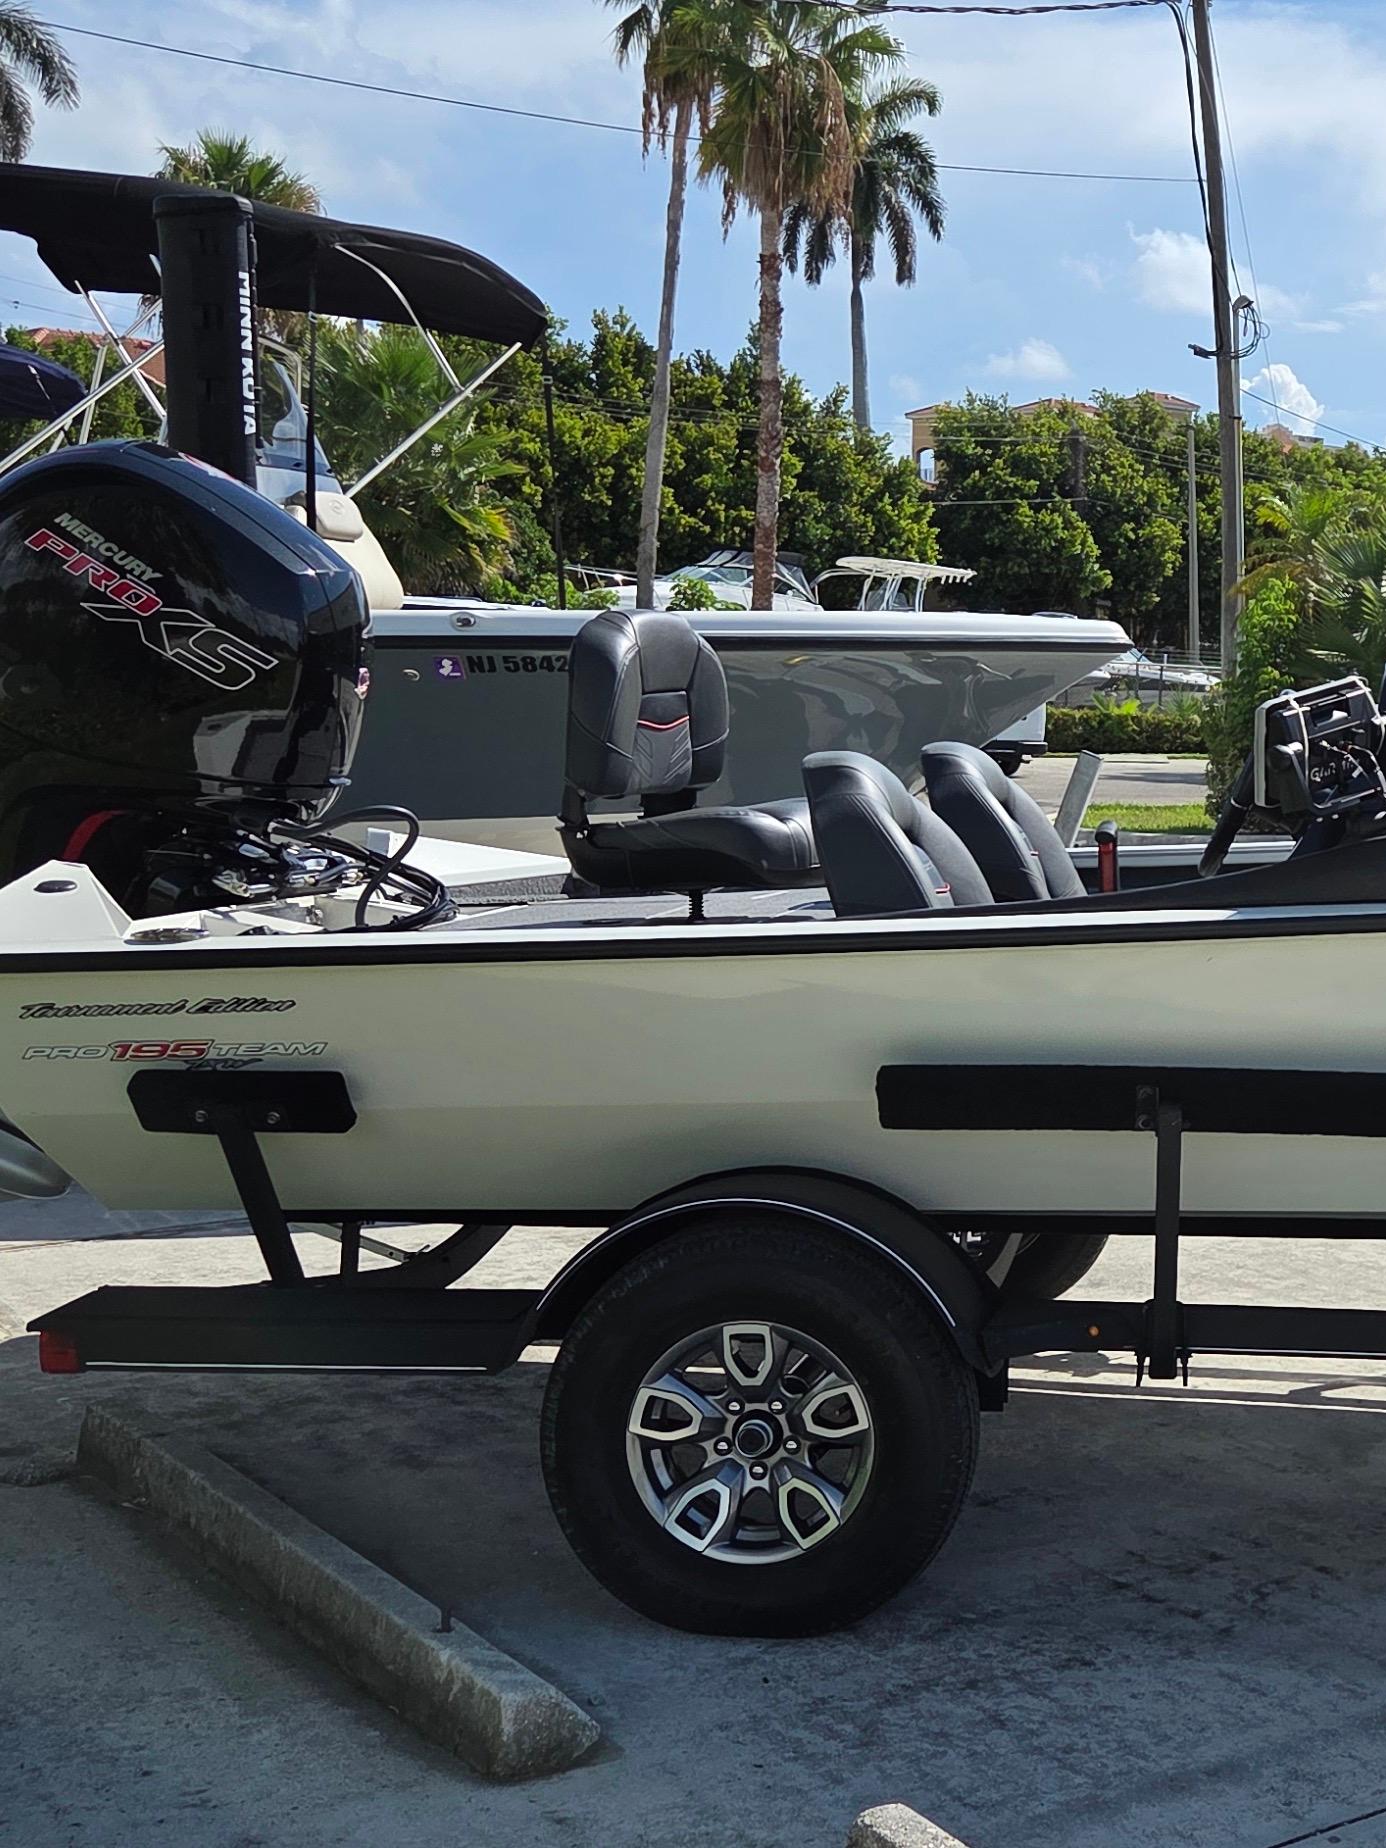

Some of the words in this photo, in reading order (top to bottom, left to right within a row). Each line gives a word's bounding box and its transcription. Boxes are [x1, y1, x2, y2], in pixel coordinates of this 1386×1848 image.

[238, 271, 253, 351] MINN
[242, 357, 257, 436] KOTA
[24, 528, 162, 616] PRO
[54, 512, 163, 581] MERCURY
[80, 602, 279, 690] XS
[467, 655, 496, 674] NJ
[502, 655, 568, 674] 5842
[19, 999, 189, 1019] Tournament
[187, 997, 296, 1014] Edition
[22, 1045, 110, 1060] PRO
[108, 1039, 214, 1062] 195
[209, 1042, 328, 1056] TEAM
